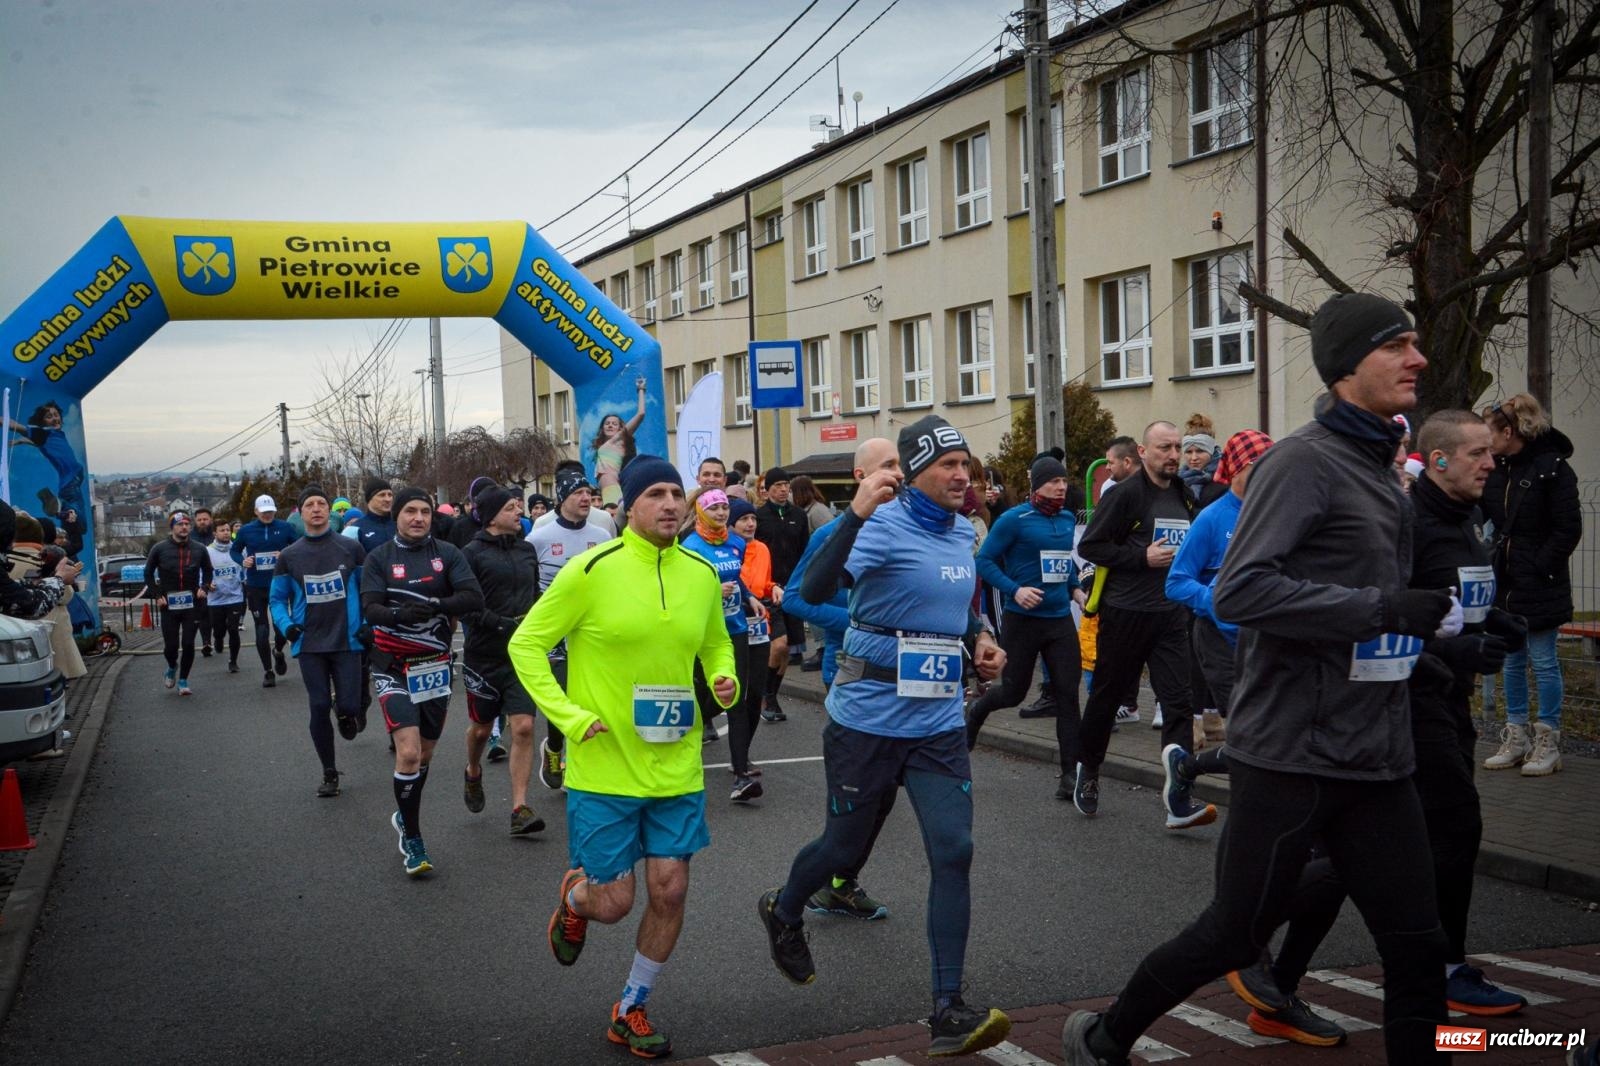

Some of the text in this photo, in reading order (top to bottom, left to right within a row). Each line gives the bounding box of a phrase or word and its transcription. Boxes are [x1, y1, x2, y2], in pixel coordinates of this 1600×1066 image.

[285, 236, 391, 253] Gmina
[259, 257, 421, 277] Pietrowice
[281, 280, 400, 299] Wielkie
[13, 254, 132, 363] Gmina ludzi
[531, 257, 635, 352] Gmina ludzi
[43, 280, 152, 383] aktywnych
[516, 281, 614, 370] aktywnych
[1162, 529, 1186, 545] 103
[262, 556, 274, 565] 27
[1049, 559, 1068, 573] 145
[941, 565, 971, 583] RUN
[312, 580, 338, 595] 111
[919, 655, 949, 680] 45
[416, 671, 444, 691] 193
[655, 701, 681, 725] 75
